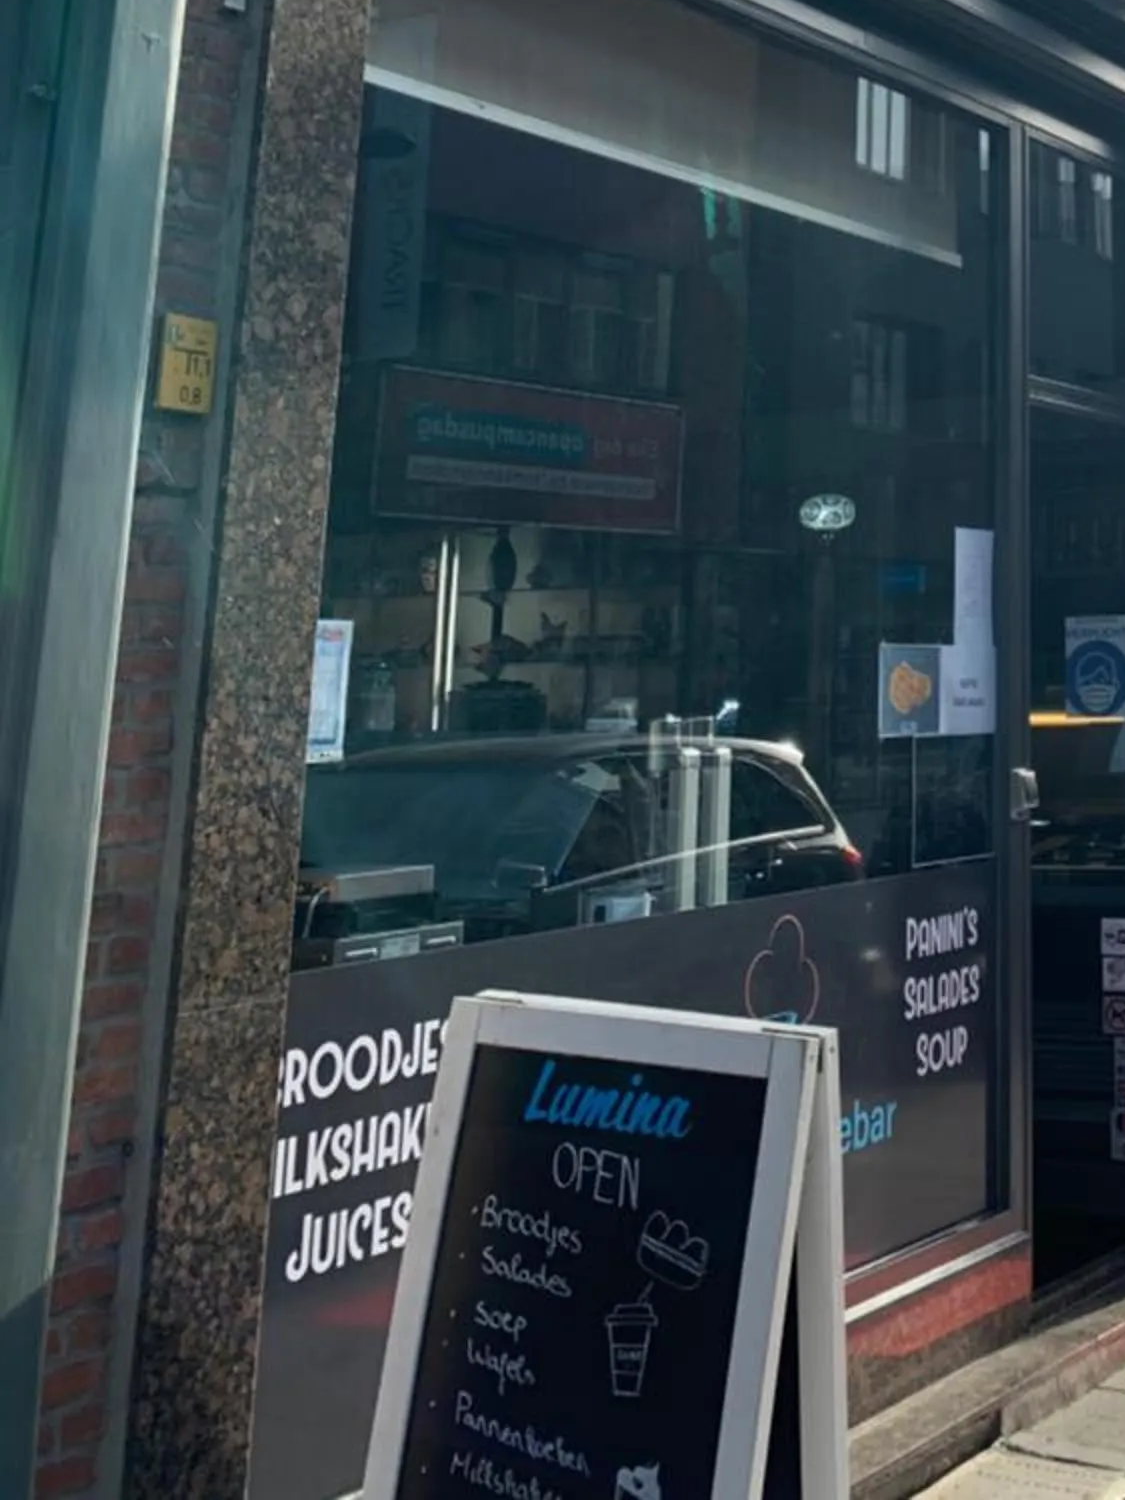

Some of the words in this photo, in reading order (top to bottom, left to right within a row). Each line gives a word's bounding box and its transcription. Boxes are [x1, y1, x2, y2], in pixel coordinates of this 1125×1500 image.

[906, 906, 978, 960] PANINI'S
[904, 964, 980, 1020] SALADES
[916, 1025, 968, 1077] SOUP
[523, 1059, 694, 1140] Lumina
[271, 1102, 433, 1198] ILKSHAK
[552, 1141, 641, 1211] OPEN
[285, 1190, 413, 1282] JUICES
[480, 1193, 583, 1257] Broodjes
[481, 1245, 572, 1298] Salades
[474, 1300, 528, 1343] Soep
